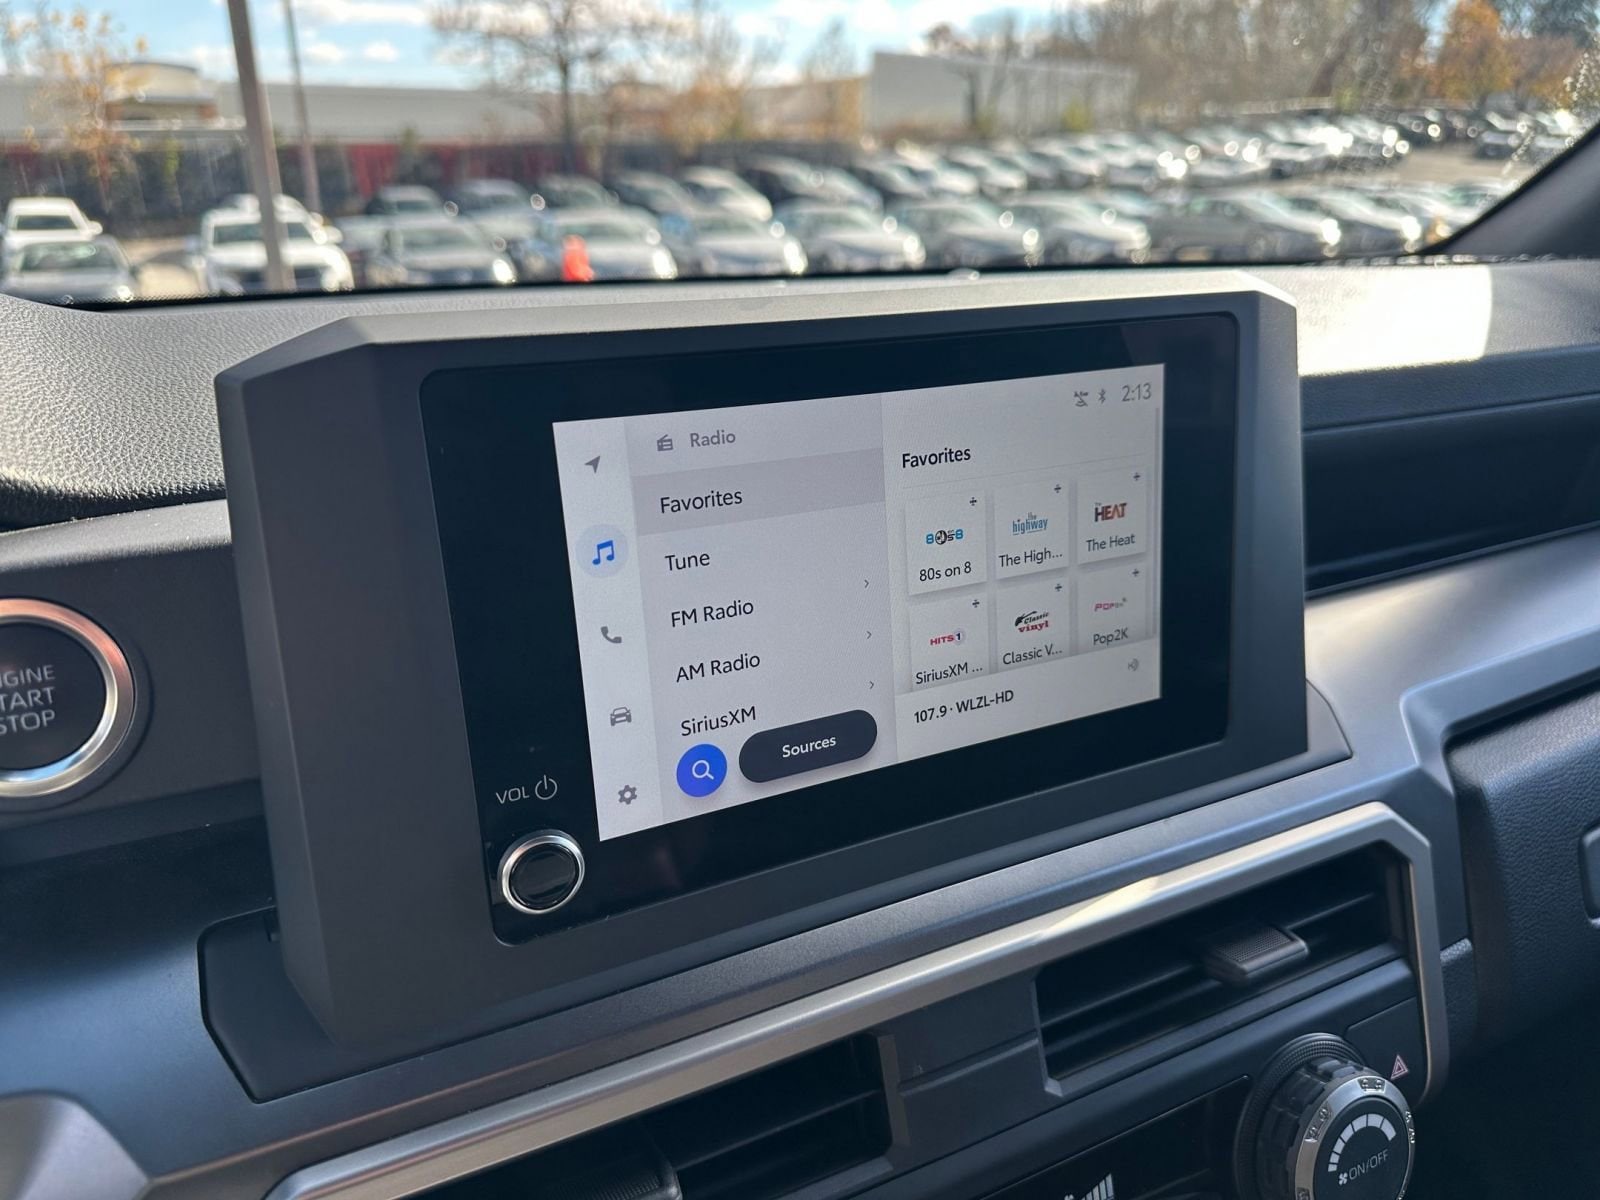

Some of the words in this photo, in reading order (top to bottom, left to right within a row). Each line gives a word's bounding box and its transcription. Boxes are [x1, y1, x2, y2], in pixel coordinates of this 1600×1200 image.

[1121, 381, 1152, 402] 2:13
[689, 429, 736, 448] Radio
[902, 447, 971, 469] Favorites
[659, 489, 743, 514] Favorites
[1094, 502, 1127, 522] HEAT
[1012, 518, 1048, 535] highway
[1085, 538, 1106, 552] The
[1109, 533, 1136, 548] Heat
[664, 551, 711, 572] Tune
[998, 552, 1021, 568] The
[1023, 548, 1063, 565] High...
[919, 565, 942, 582] 80s
[944, 564, 962, 578] on
[963, 561, 972, 575] 8
[671, 608, 698, 628] FM
[703, 600, 754, 622] Radio
[1018, 620, 1049, 632] vinyl
[1093, 626, 1129, 646] Pop2K
[929, 634, 955, 646] HITS
[1002, 647, 1043, 666] Classic
[0, 664, 56, 688] GINE
[675, 662, 705, 683] AM
[710, 653, 761, 676] Radio
[915, 662, 969, 685] SiriusXM
[913, 705, 948, 724] 107.9
[955, 690, 1015, 714] WLZL-HD
[680, 706, 757, 737] SiriusXM
[781, 735, 837, 759] Sources
[495, 786, 530, 805] VOL
[1349, 1149, 1389, 1181] ON/OFF
